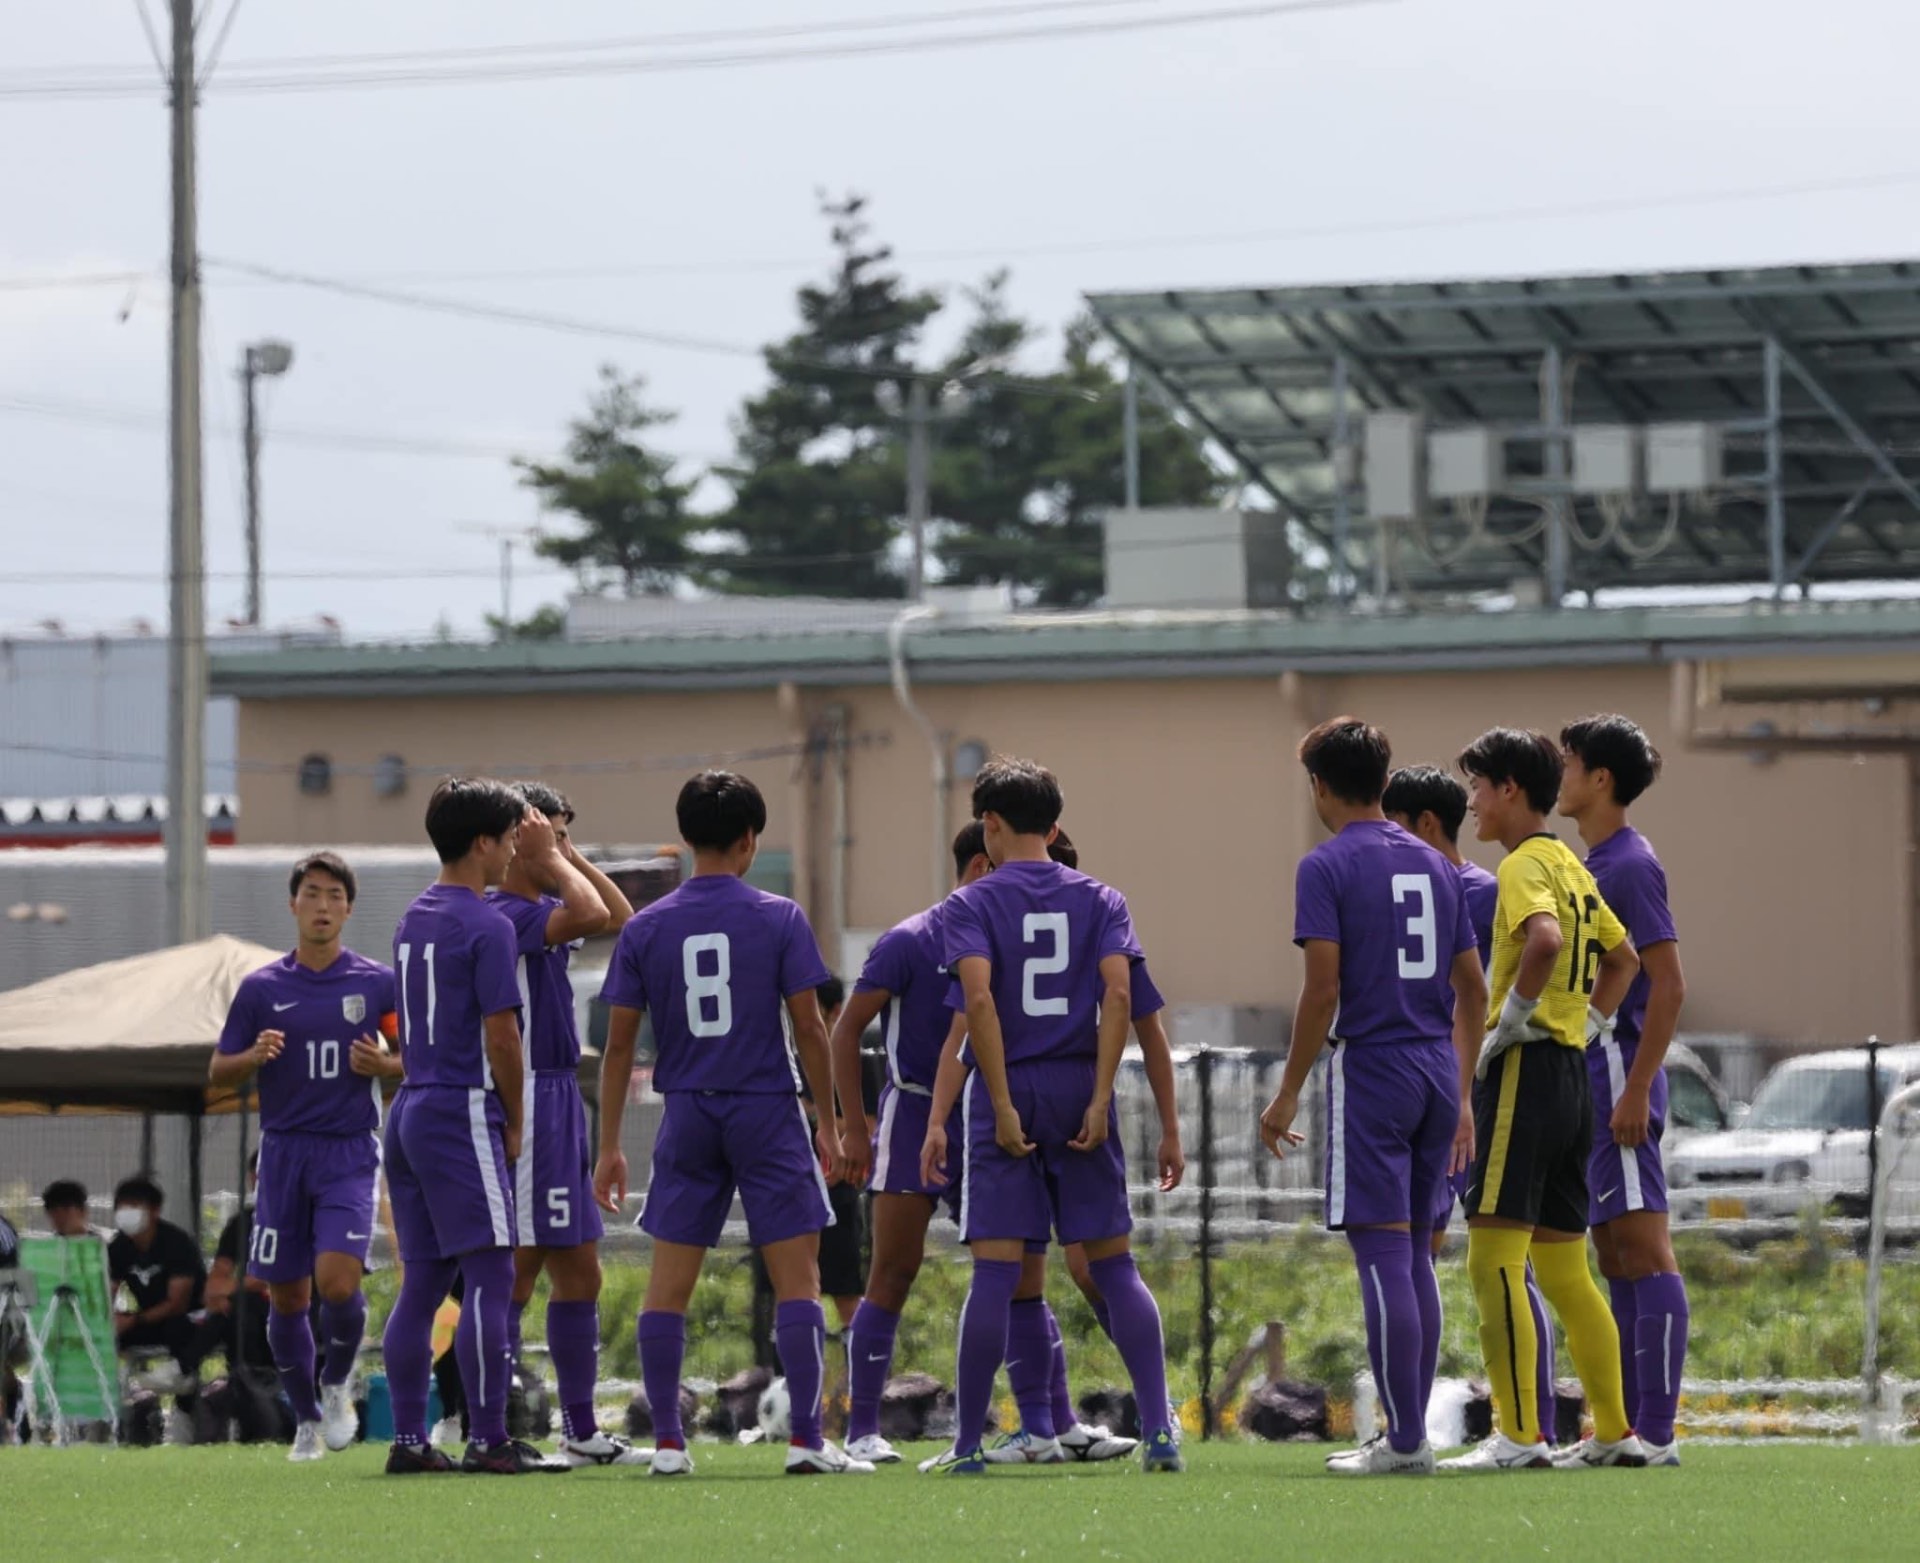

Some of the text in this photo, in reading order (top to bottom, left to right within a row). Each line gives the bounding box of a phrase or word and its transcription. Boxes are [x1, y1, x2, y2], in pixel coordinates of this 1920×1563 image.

[1022, 912, 1069, 1016] 2
[1392, 874, 1436, 978] 3
[398, 942, 437, 1046] 11
[682, 932, 732, 1037] 8
[306, 1040, 340, 1079] 10
[250, 1224, 278, 1264] 10
[547, 1186, 570, 1228] 5
